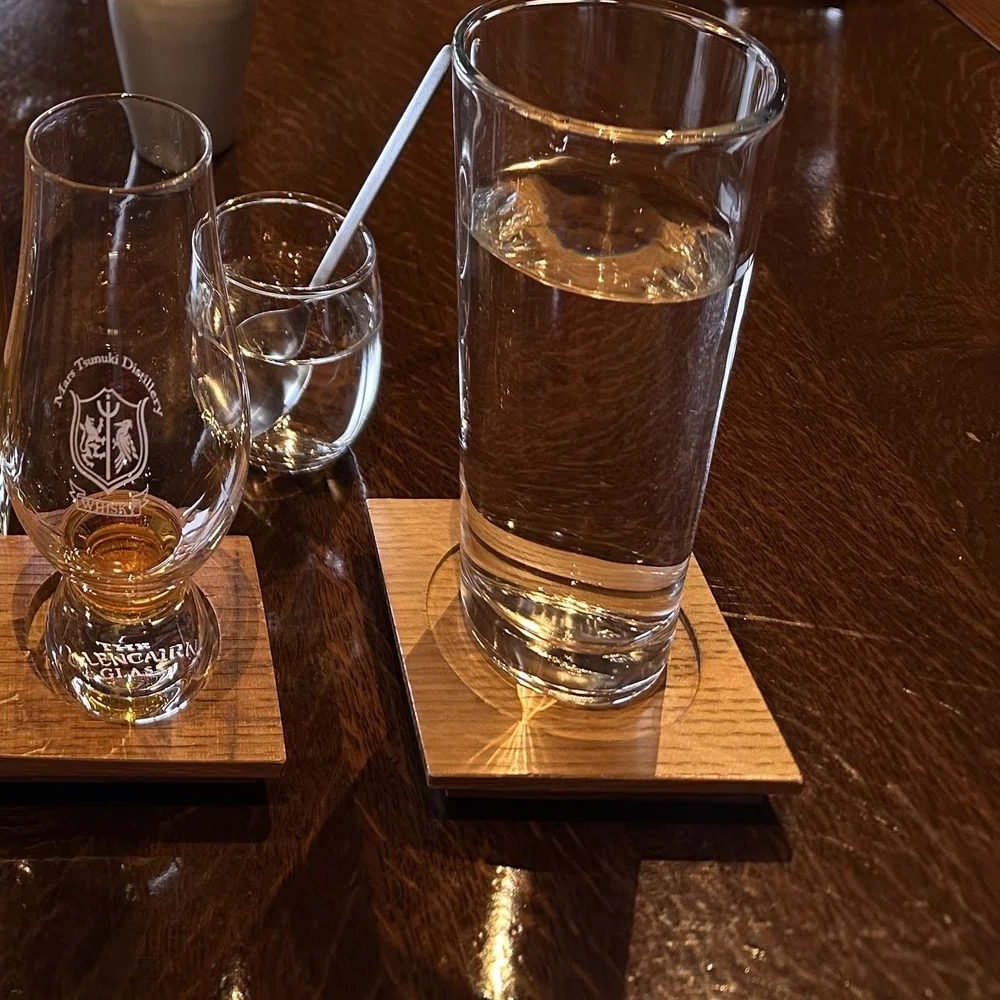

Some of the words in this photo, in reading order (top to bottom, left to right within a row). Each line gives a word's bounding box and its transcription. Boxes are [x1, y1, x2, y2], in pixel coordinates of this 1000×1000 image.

[53, 368, 76, 409] Mars
[73, 352, 119, 371] Tsunuki
[121, 355, 164, 417] Distillery
[81, 499, 138, 515] WHISKY
